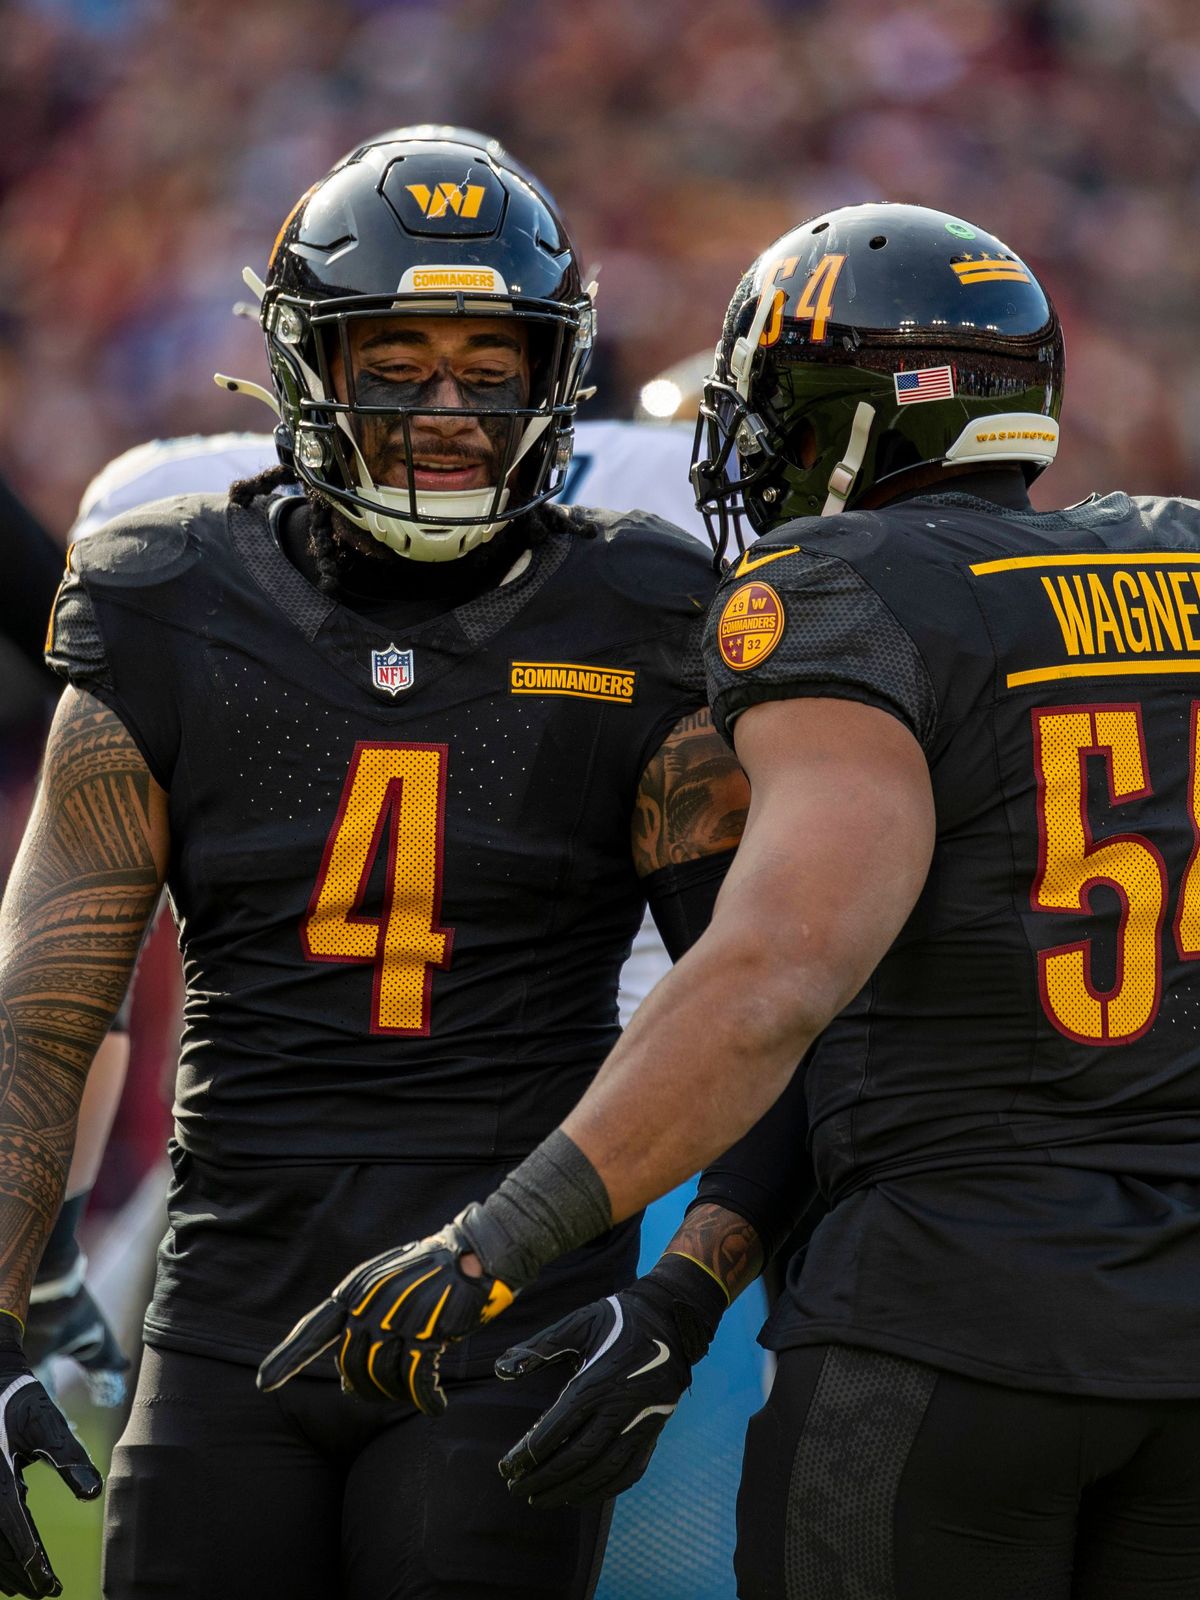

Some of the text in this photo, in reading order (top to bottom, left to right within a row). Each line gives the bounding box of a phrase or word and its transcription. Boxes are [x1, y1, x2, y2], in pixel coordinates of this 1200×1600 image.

[413, 274, 494, 287] COMMANDERS
[976, 431, 1056, 442] WASHINGTON
[733, 602, 744, 613] 19
[751, 597, 767, 610] W
[722, 616, 776, 635] COMMANDERS
[747, 639, 761, 650] 32
[379, 667, 407, 683] NFL
[511, 667, 634, 697] COMMANDERS
[1031, 700, 1200, 1046] 5
[300, 740, 455, 1037] 4
